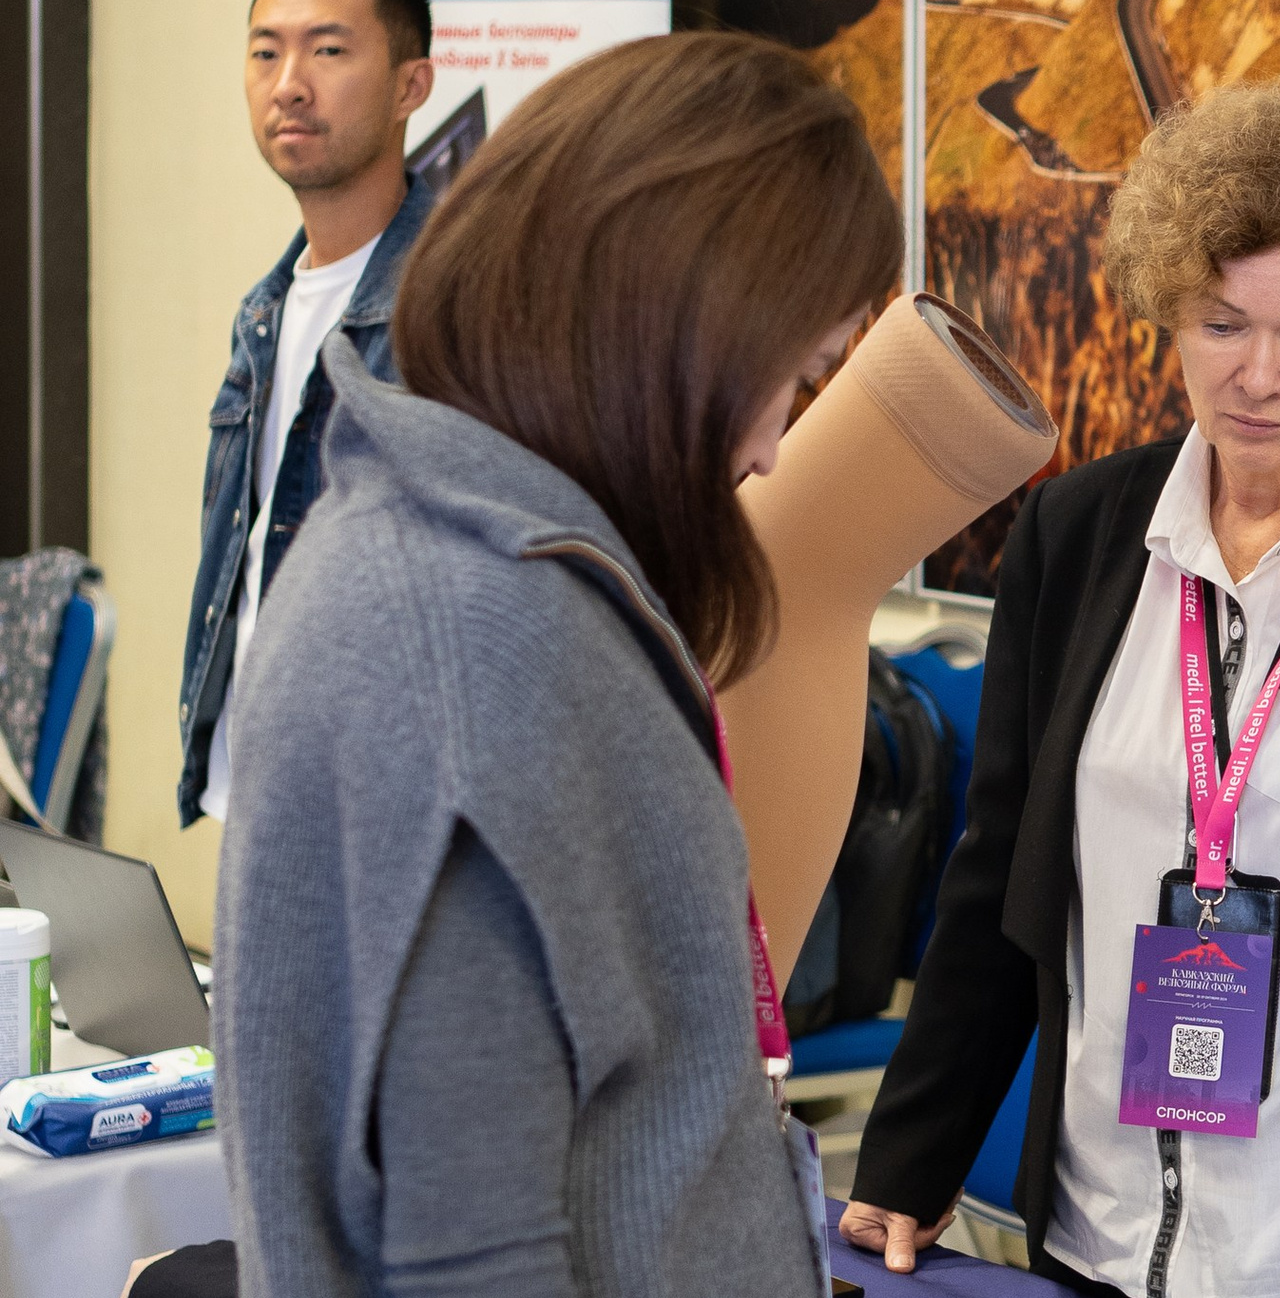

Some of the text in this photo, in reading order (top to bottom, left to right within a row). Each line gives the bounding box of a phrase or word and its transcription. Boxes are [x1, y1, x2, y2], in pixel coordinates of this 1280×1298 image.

[1185, 575, 1197, 622] etter.
[1186, 653, 1199, 697] medi.
[1188, 706, 1207, 739] feel
[1191, 742, 1209, 802] better.
[1222, 755, 1250, 803] medi.
[1242, 711, 1265, 748] feel
[1158, 977, 1248, 995] ВЕНОЗНЫЙ ФОРУМ
[1171, 968, 1235, 983] КАВКАЗСКИЙ
[100, 1112, 135, 1128] AURA
[1156, 1106, 1227, 1124] СПОНСОР
